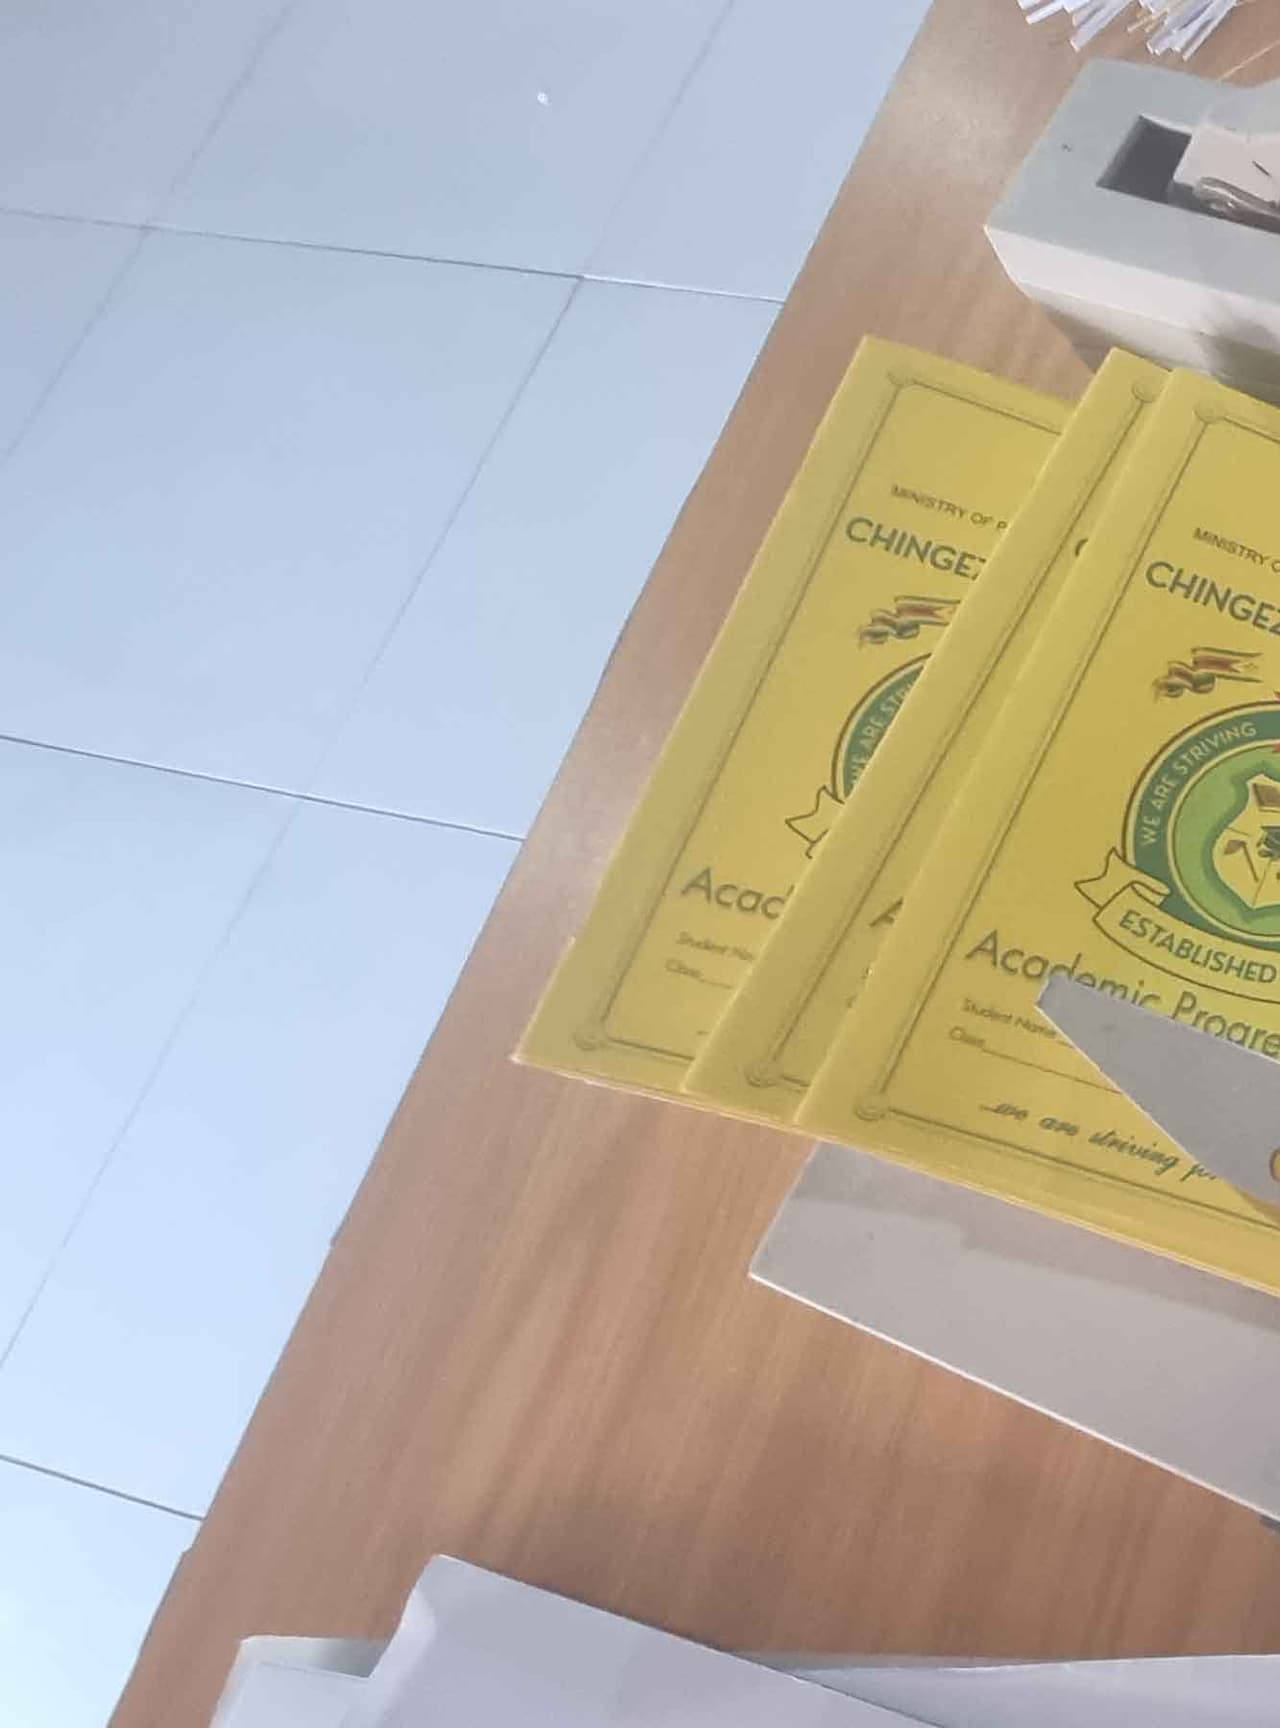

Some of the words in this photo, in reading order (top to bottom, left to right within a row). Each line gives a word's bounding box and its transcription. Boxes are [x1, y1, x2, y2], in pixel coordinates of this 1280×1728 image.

[891, 485, 966, 519] MINISTRY
[845, 516, 986, 581] CHINGE
[1192, 526, 1269, 566] MINISTRY
[1140, 814, 1161, 846] WE
[1152, 777, 1176, 811] ARE
[1172, 722, 1258, 774] STRIVING
[1119, 908, 1277, 984] ESTABLISHED
[1038, 1116, 1079, 1136] are
[1088, 1130, 1181, 1176] driving
